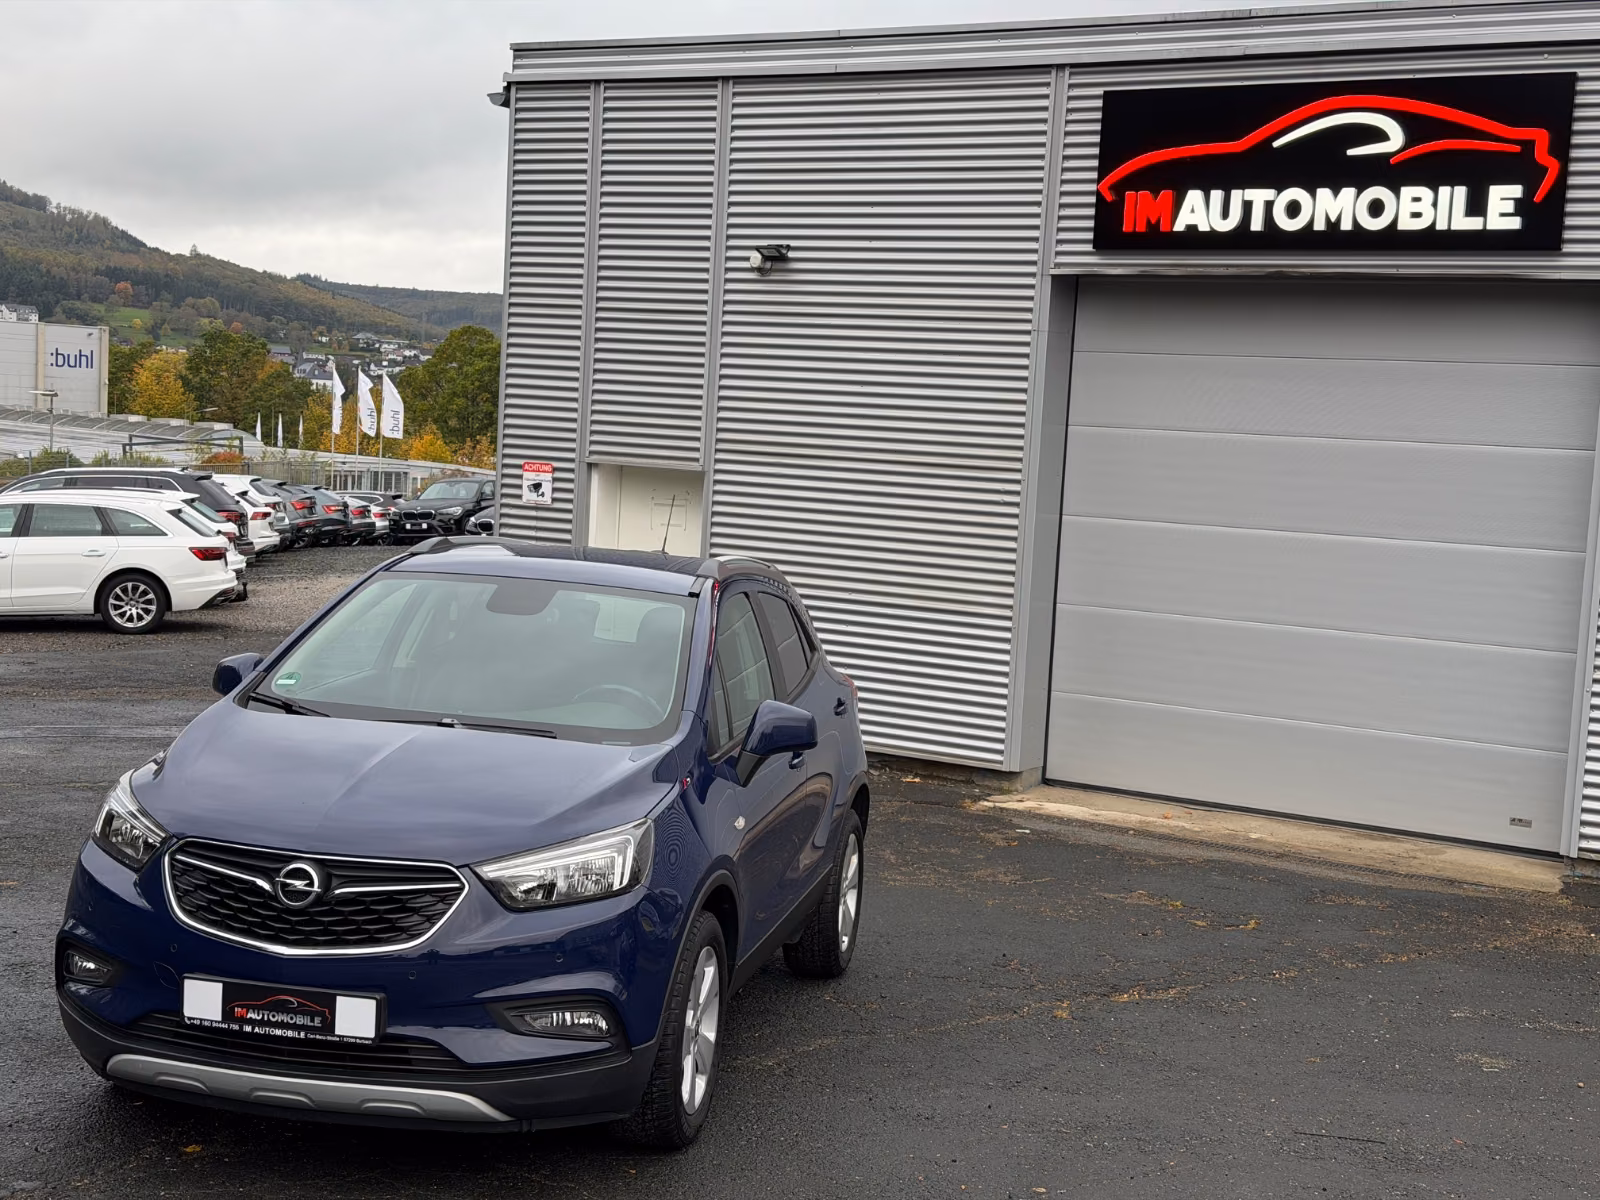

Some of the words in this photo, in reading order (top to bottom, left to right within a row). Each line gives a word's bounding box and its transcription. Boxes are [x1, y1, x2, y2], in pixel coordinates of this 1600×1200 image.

[50, 347, 94, 369] :buhl
[524, 463, 552, 472] ACHTUNG
[254, 1027, 306, 1039] AUTOMOBILE
